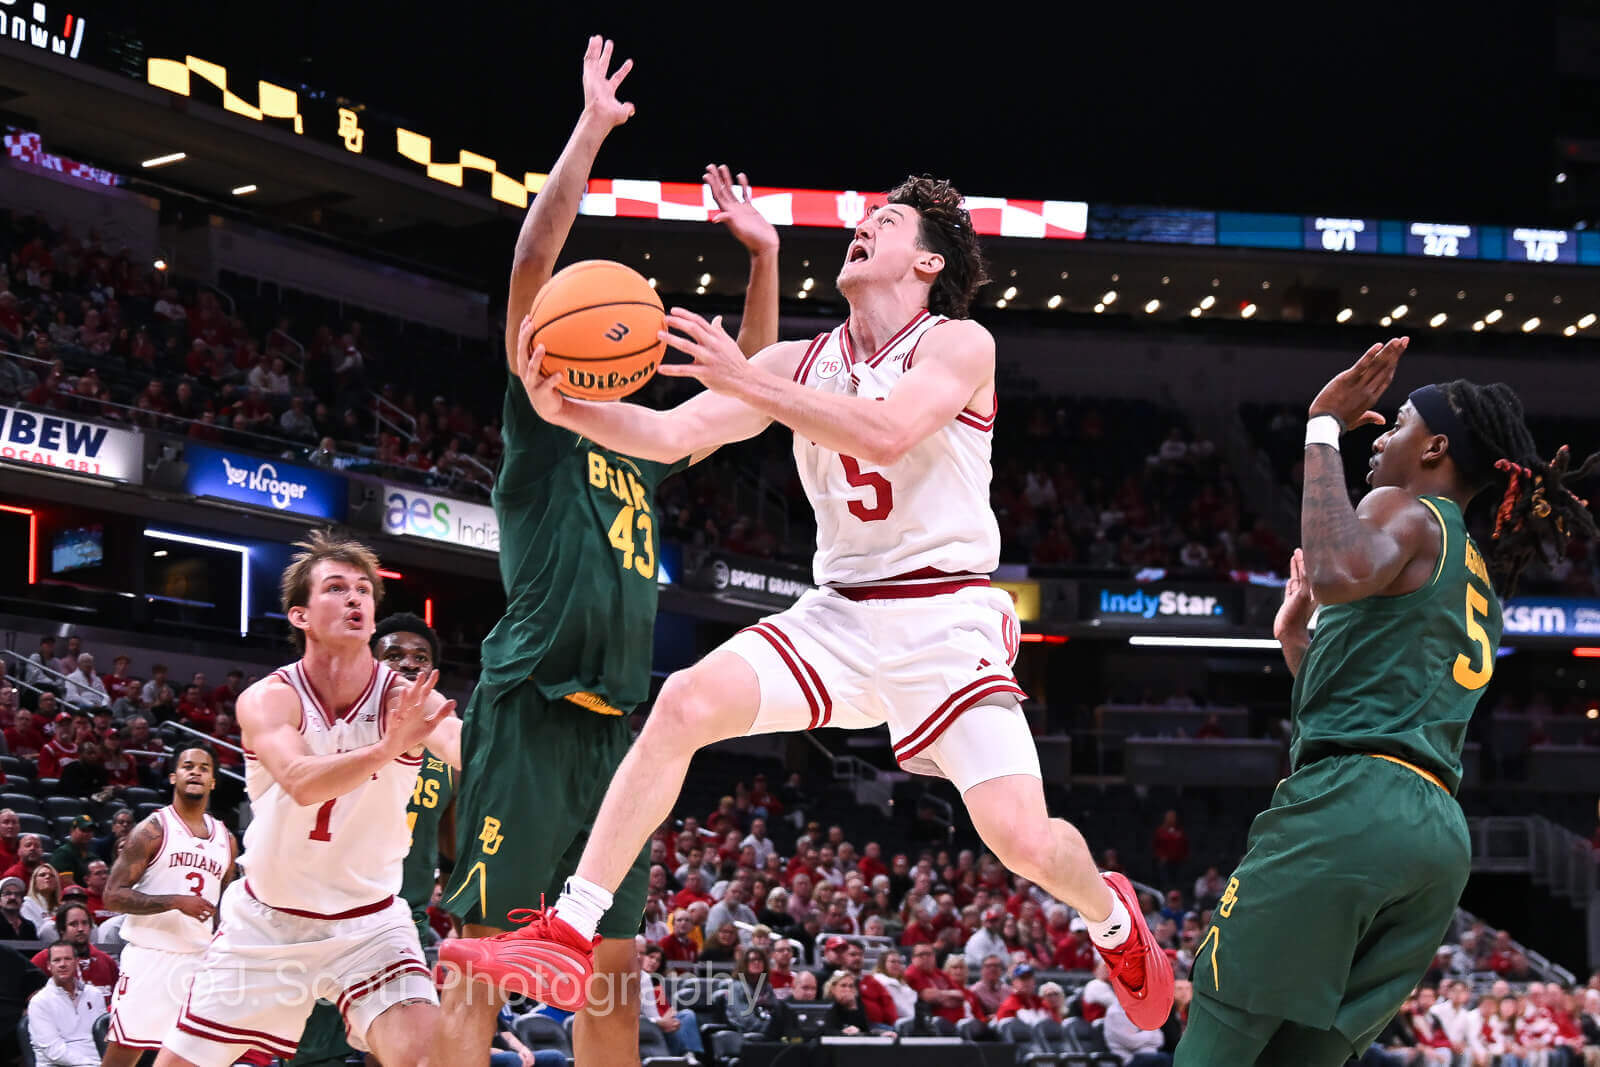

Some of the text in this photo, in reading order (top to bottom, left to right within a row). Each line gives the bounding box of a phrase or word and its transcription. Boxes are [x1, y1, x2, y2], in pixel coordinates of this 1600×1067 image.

[566, 361, 656, 390] Wilson
[821, 361, 839, 374] 76
[0, 446, 101, 475] OCAL 481
[248, 463, 307, 509] Kroger
[838, 452, 894, 522] 5
[386, 492, 500, 547] aes India
[607, 504, 655, 580] 43
[730, 569, 766, 592] SPORT
[1452, 582, 1493, 690] 5
[308, 797, 337, 843] 1
[168, 851, 223, 881] INDIANA
[185, 871, 205, 897] 3
